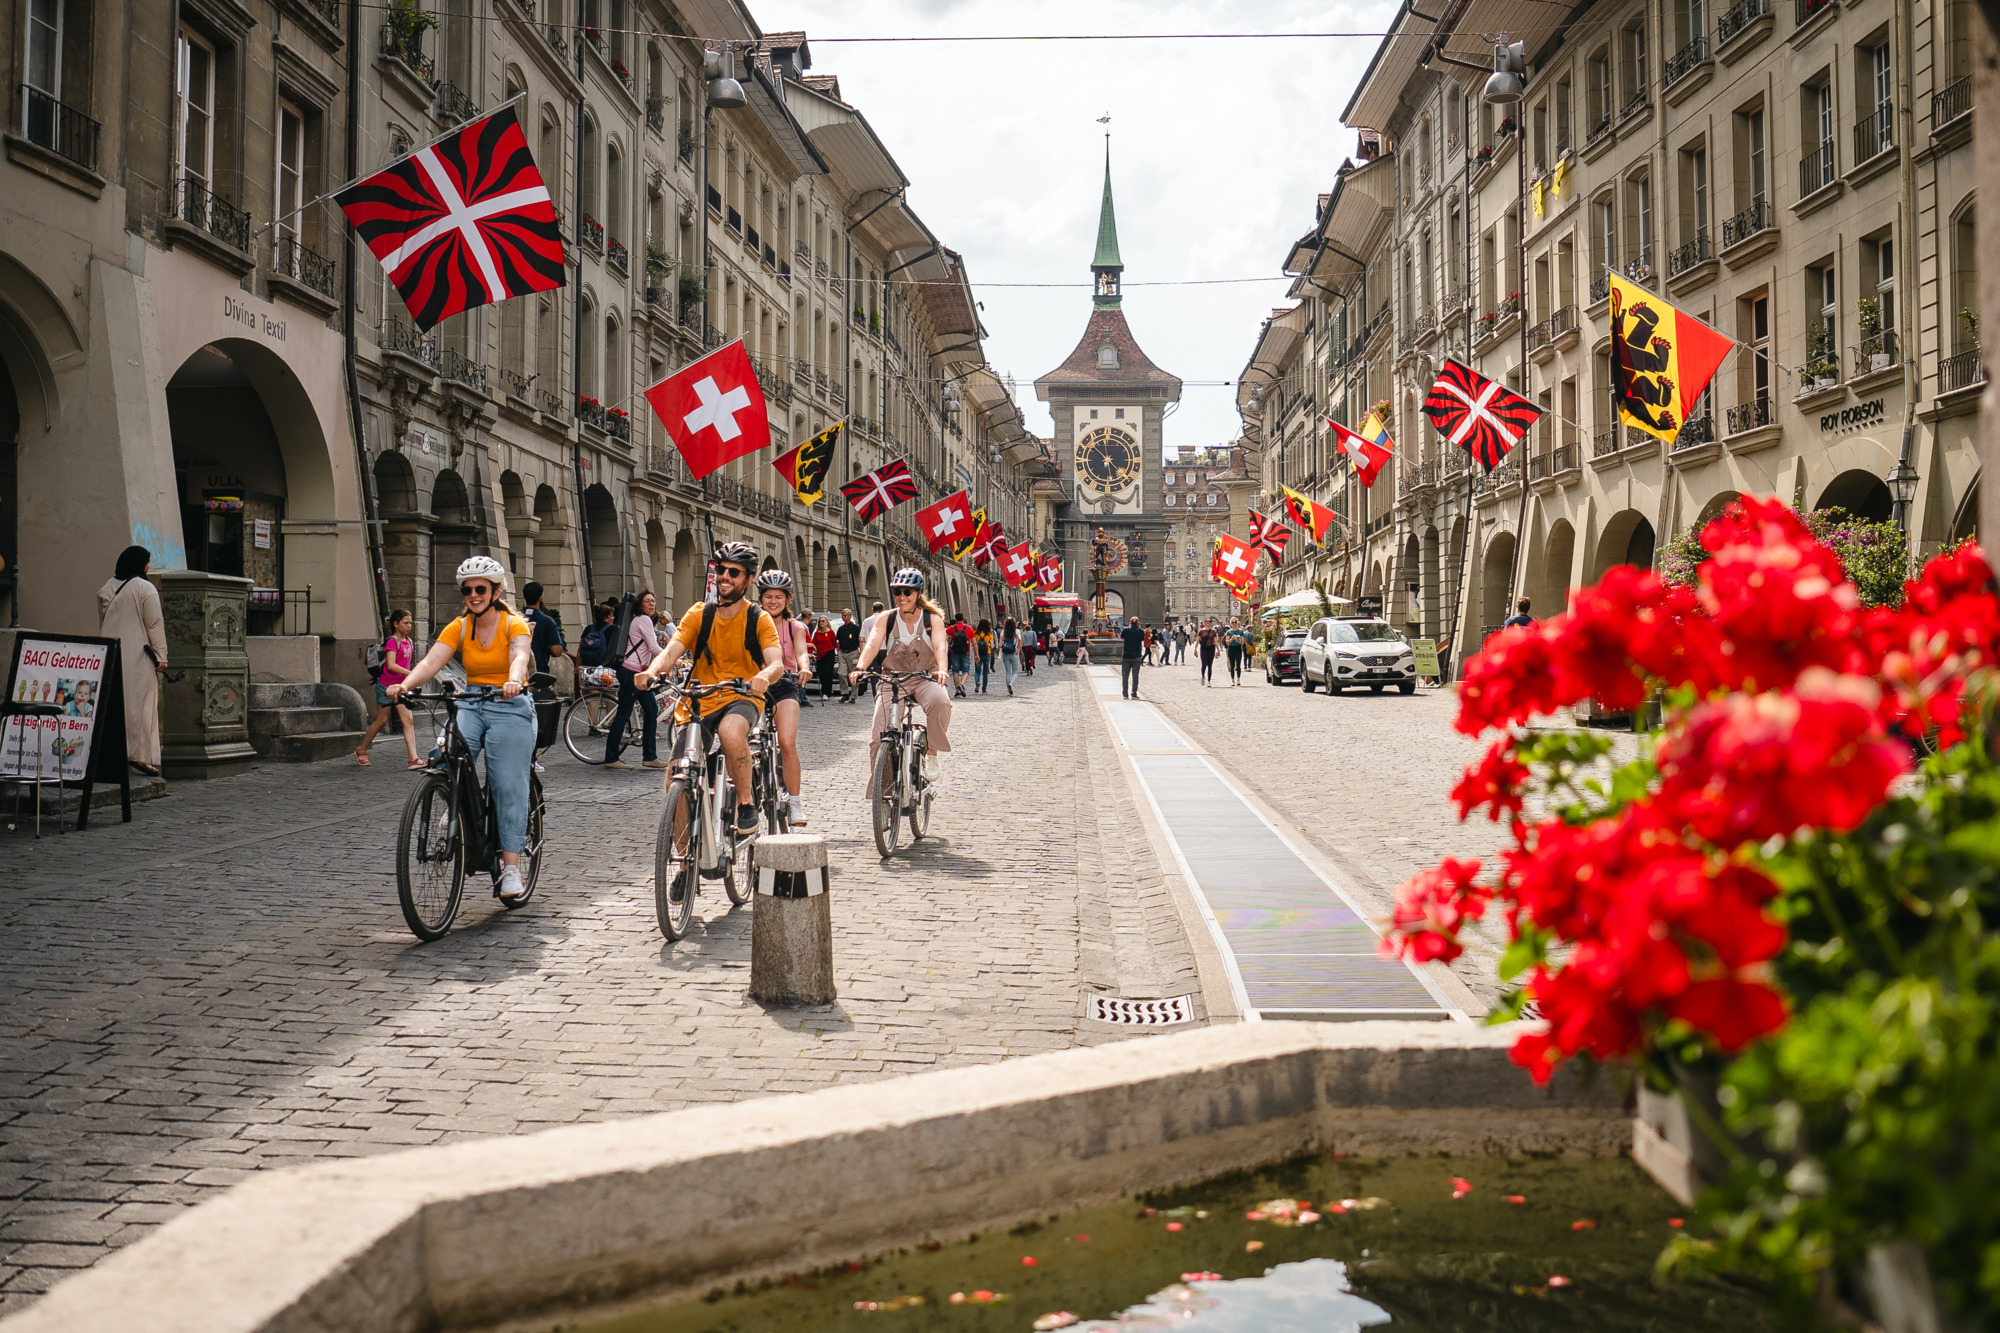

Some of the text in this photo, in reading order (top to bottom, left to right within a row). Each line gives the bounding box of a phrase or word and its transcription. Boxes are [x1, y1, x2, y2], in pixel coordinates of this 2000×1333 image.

[225, 296, 286, 341] Divina Textil
[1820, 398, 1884, 432] ROY ROBSON
[23, 650, 101, 671] BACI Gelateria
[13, 715, 57, 731] Eizigrtig
[69, 720, 89, 731] Bern
